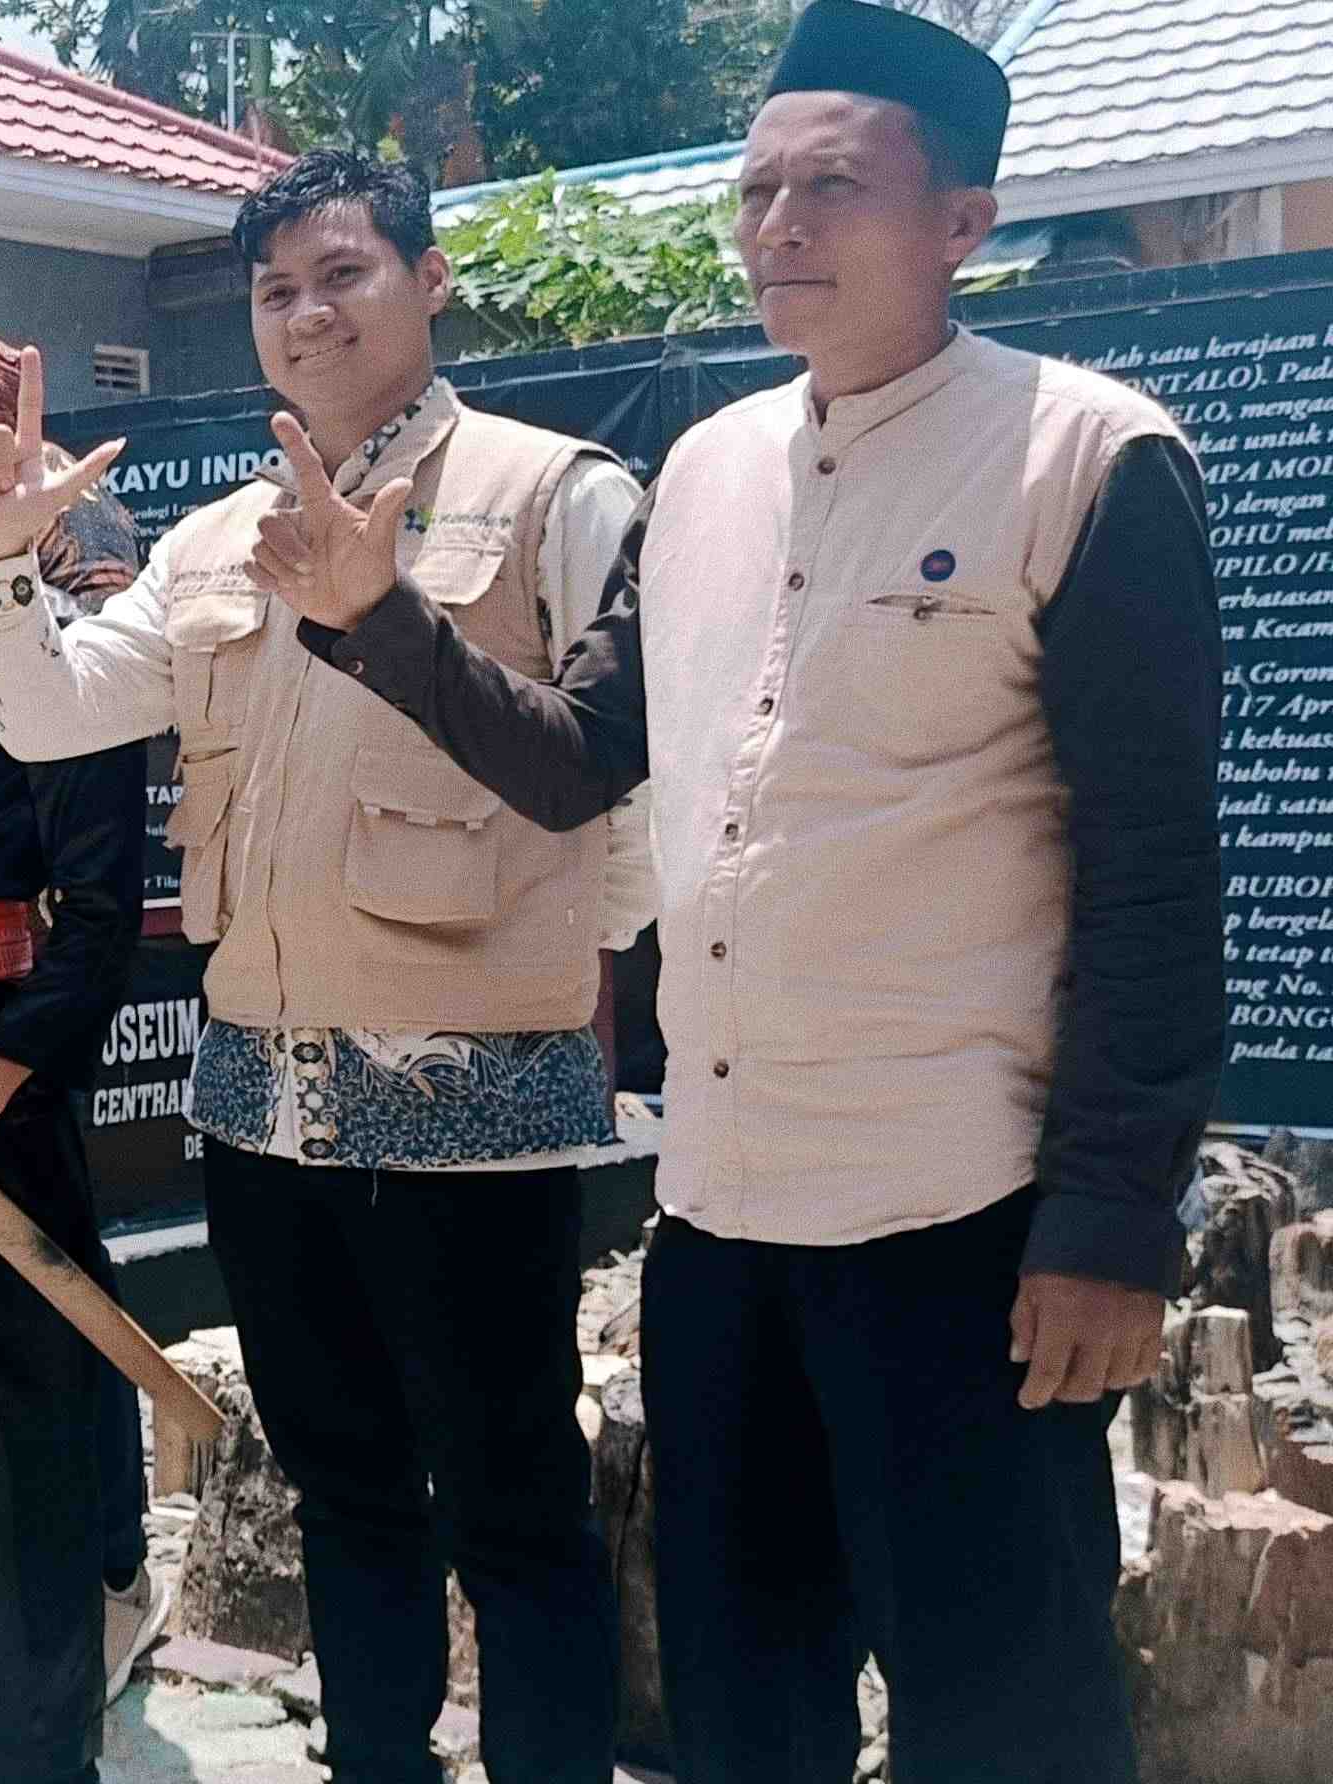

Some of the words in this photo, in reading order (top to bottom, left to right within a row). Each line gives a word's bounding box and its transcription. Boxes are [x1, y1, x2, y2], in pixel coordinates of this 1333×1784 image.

[1147, 347, 1200, 366] satu
[1205, 332, 1317, 361] kerajaan
[1243, 422, 1322, 451] untuk
[106, 458, 190, 495] KAYU
[1234, 490, 1326, 518] dengan
[1209, 523, 1285, 548] OHU
[1239, 694, 1276, 717] 17
[1245, 944, 1315, 969] tetap
[1274, 973, 1326, 996] No.
[1229, 1003, 1333, 1029] BONG
[1229, 1036, 1299, 1065] pada
